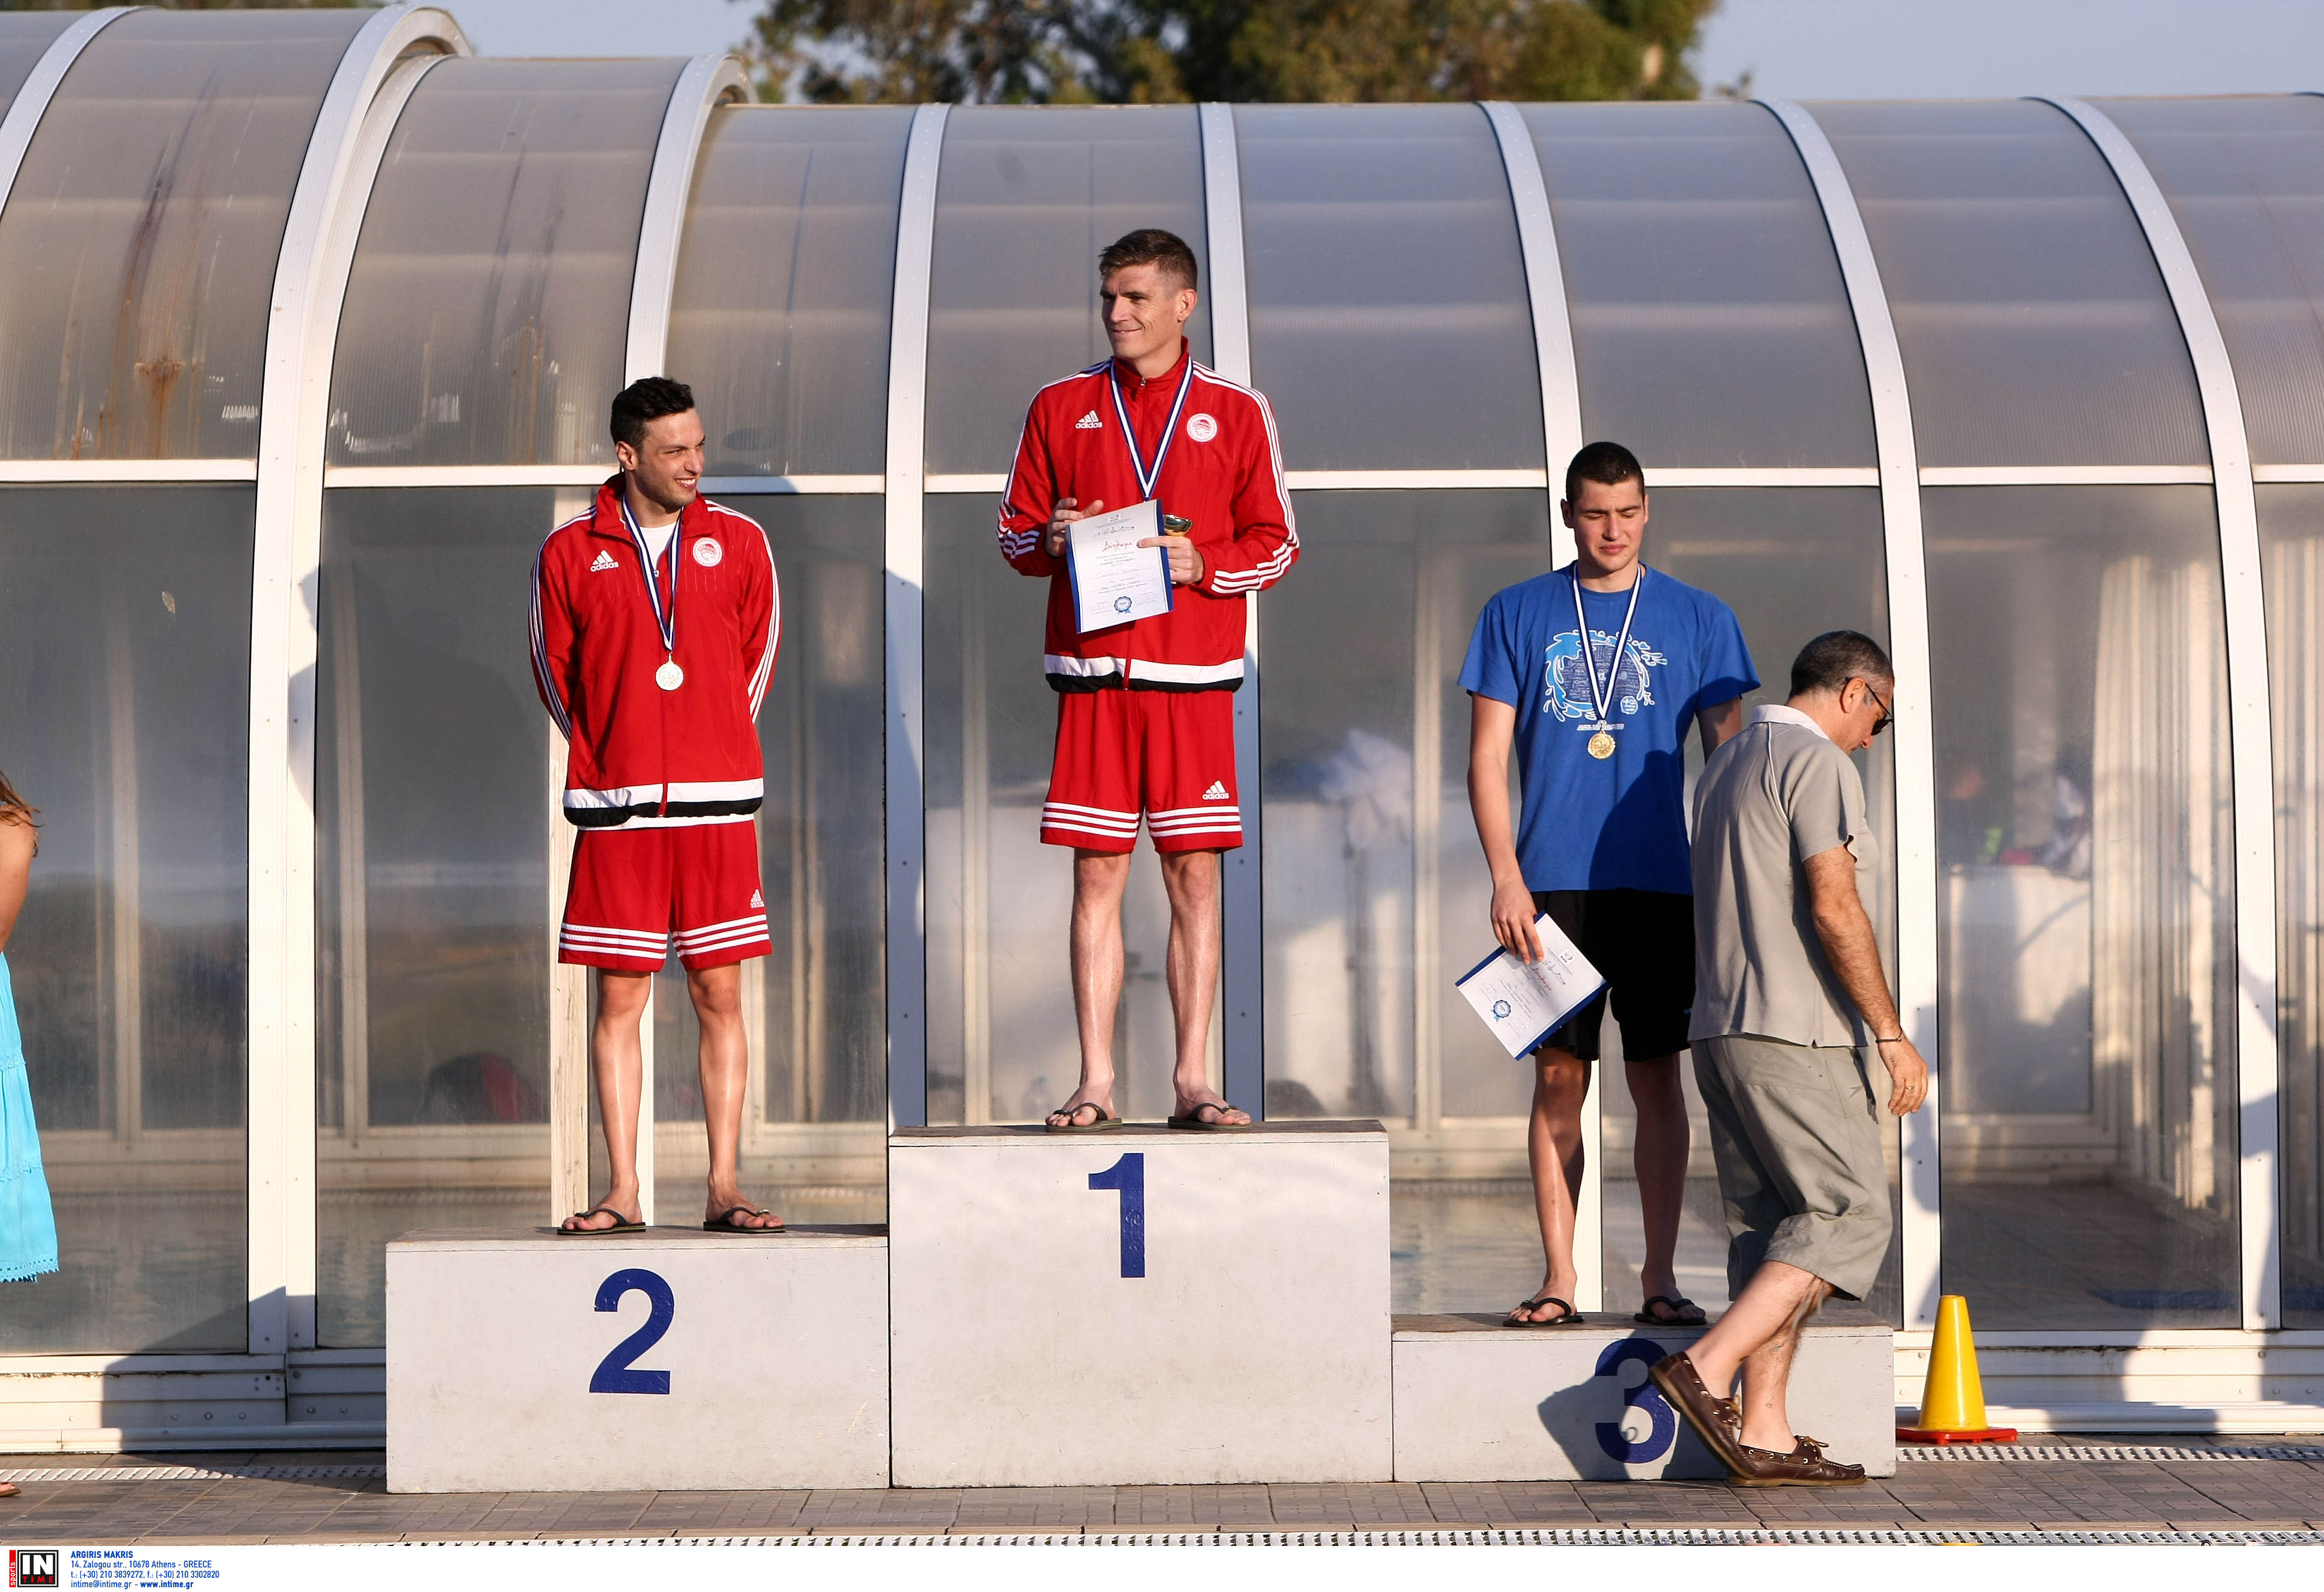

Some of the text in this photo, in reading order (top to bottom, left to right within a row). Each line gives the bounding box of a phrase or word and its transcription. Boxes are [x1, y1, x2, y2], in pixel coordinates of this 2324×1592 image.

[1075, 421, 1103, 429] adidas
[590, 561, 619, 572] adidas
[1087, 1152, 1146, 1279] 1
[589, 1268, 675, 1395] 2
[1594, 1337, 1676, 1464] 3
